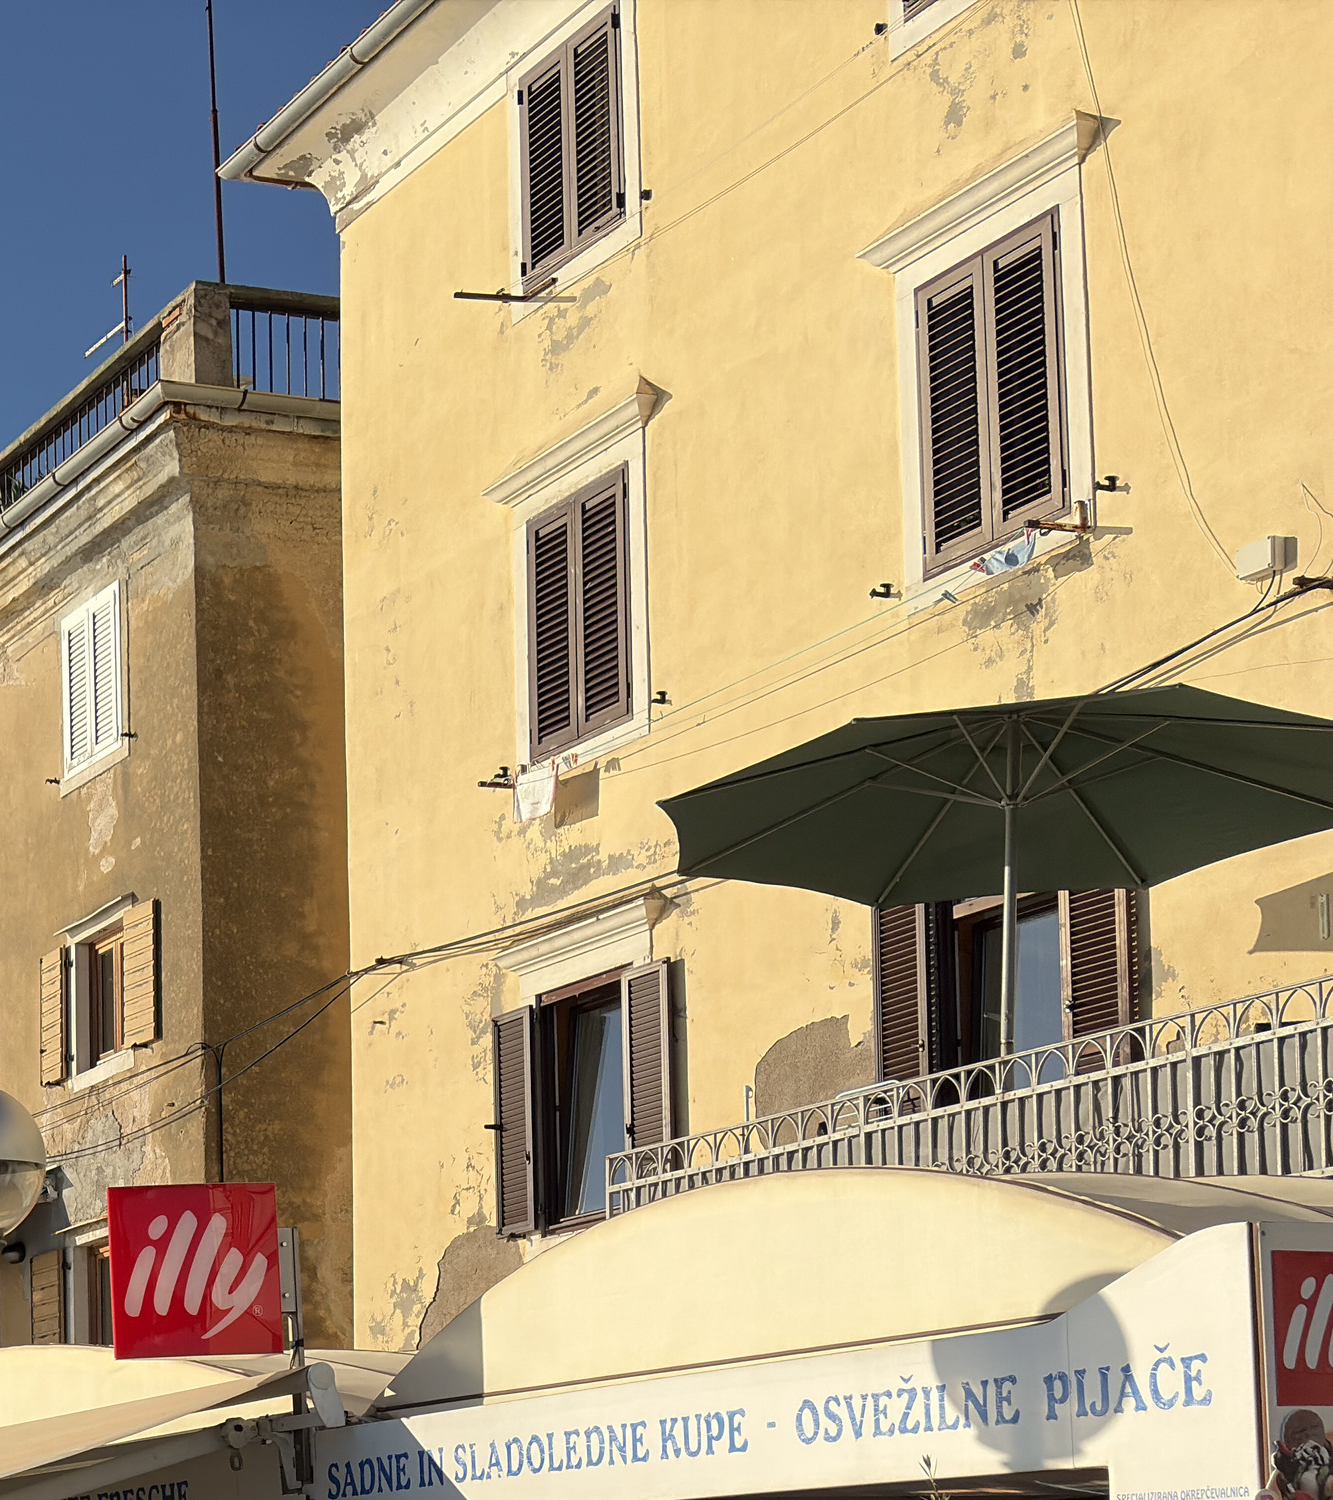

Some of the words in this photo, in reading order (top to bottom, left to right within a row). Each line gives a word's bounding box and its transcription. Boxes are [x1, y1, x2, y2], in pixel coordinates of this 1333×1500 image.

[124, 1210, 268, 1339] illy
[1283, 1273, 1333, 1369] il
[327, 1451, 411, 1500] SADNE
[418, 1447, 445, 1488] IN
[454, 1419, 650, 1484] SLADOLEDNE
[660, 1408, 750, 1462] KUPE
[795, 1374, 1021, 1445] OSVEŽILNE
[1043, 1342, 1213, 1422] PIJAČE
[1180, 1485, 1250, 1500] OKREPČEVALNICA
